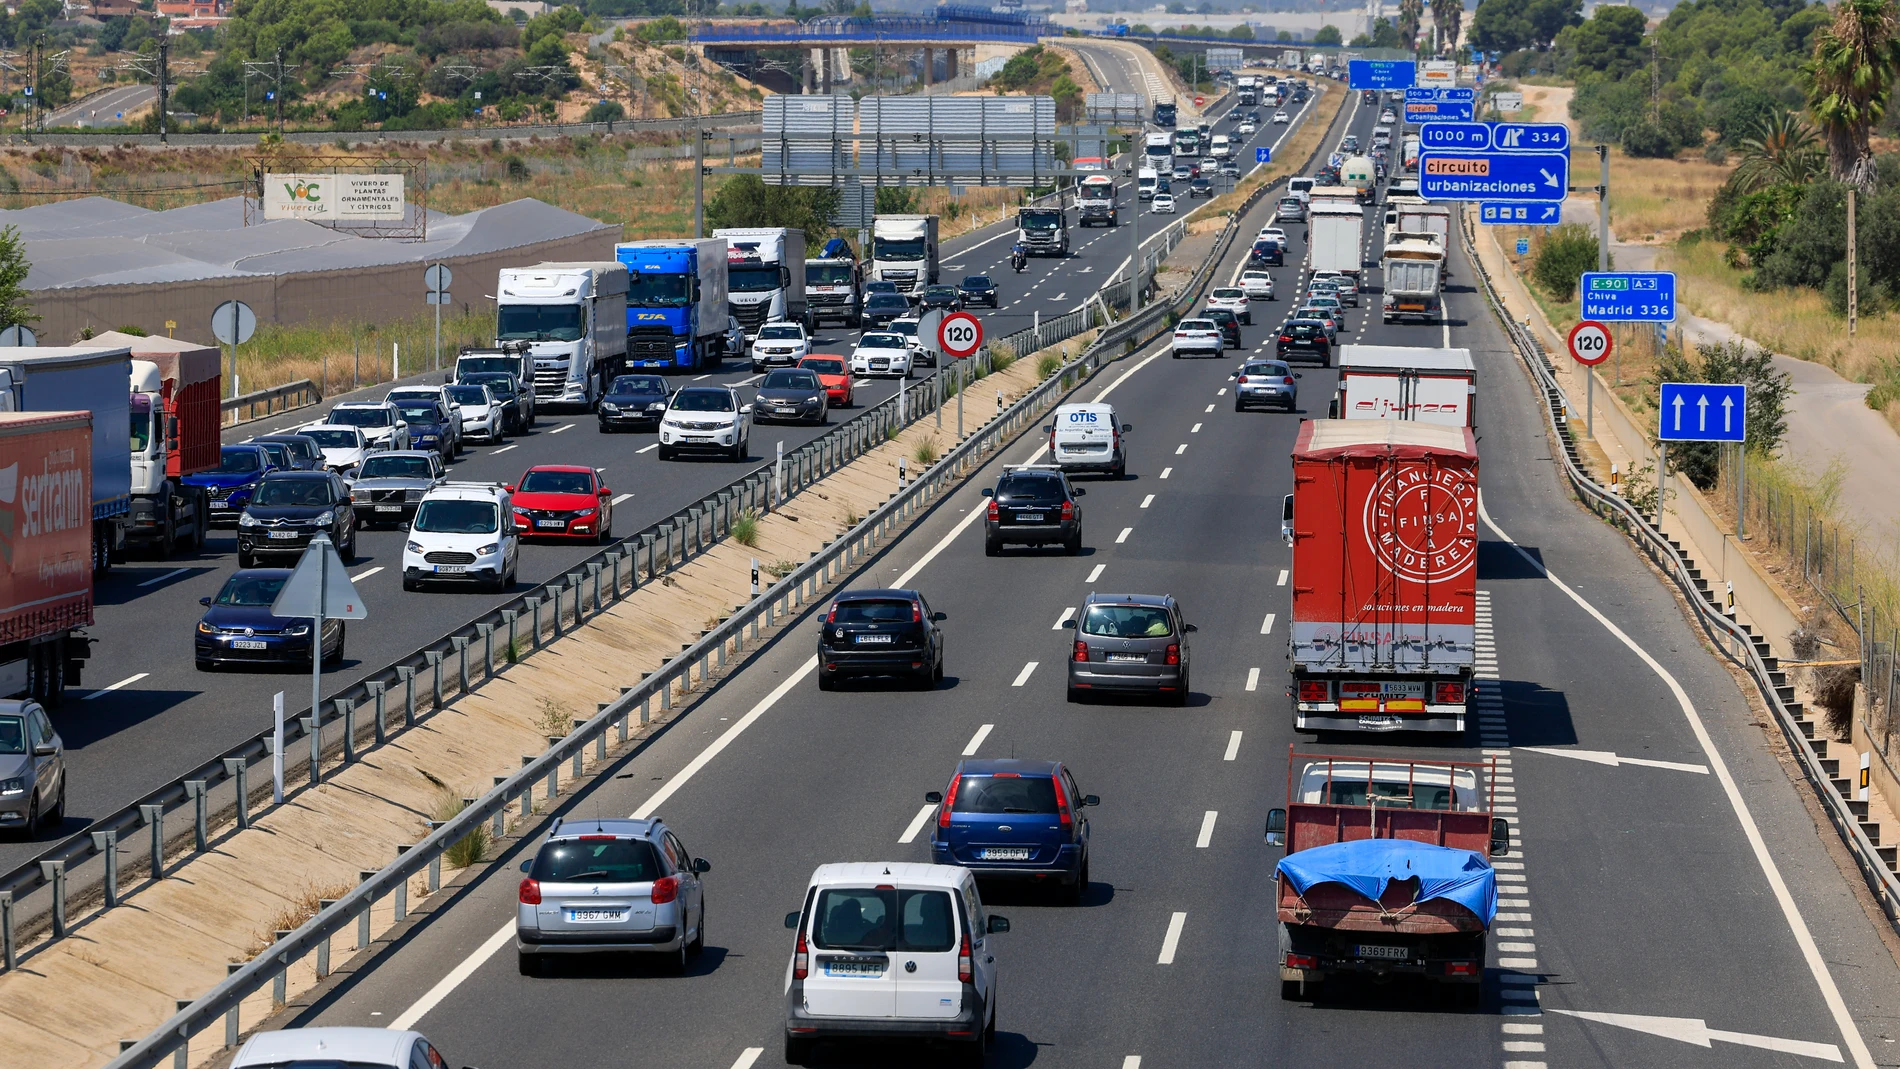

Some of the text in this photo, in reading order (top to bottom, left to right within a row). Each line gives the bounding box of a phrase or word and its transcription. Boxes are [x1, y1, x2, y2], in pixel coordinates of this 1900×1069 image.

[1407, 104, 1437, 112] circuito
[1408, 113, 1459, 121] urbanizaciones
[1428, 130, 1483, 142] 1000 m
[1531, 132, 1561, 143] 334
[1427, 160, 1488, 174] circuito
[1427, 179, 1536, 193] urbanizaciones
[1592, 279, 1656, 289] E-901 A-3
[1587, 292, 1669, 300] Chiva 11
[1587, 304, 1669, 316] Madrid 336
[947, 326, 974, 342] 120
[1577, 335, 1604, 351] 120
[1069, 412, 1098, 423] OTIS
[1412, 603, 1424, 612] en
[1427, 602, 1465, 613] madera
[234, 641, 251, 649] 3223
[1389, 684, 1407, 692] 5633
[576, 910, 622, 920] 9967 GMM
[1360, 946, 1407, 958] 9369 FRK
[831, 963, 880, 974] 8895 MFF
